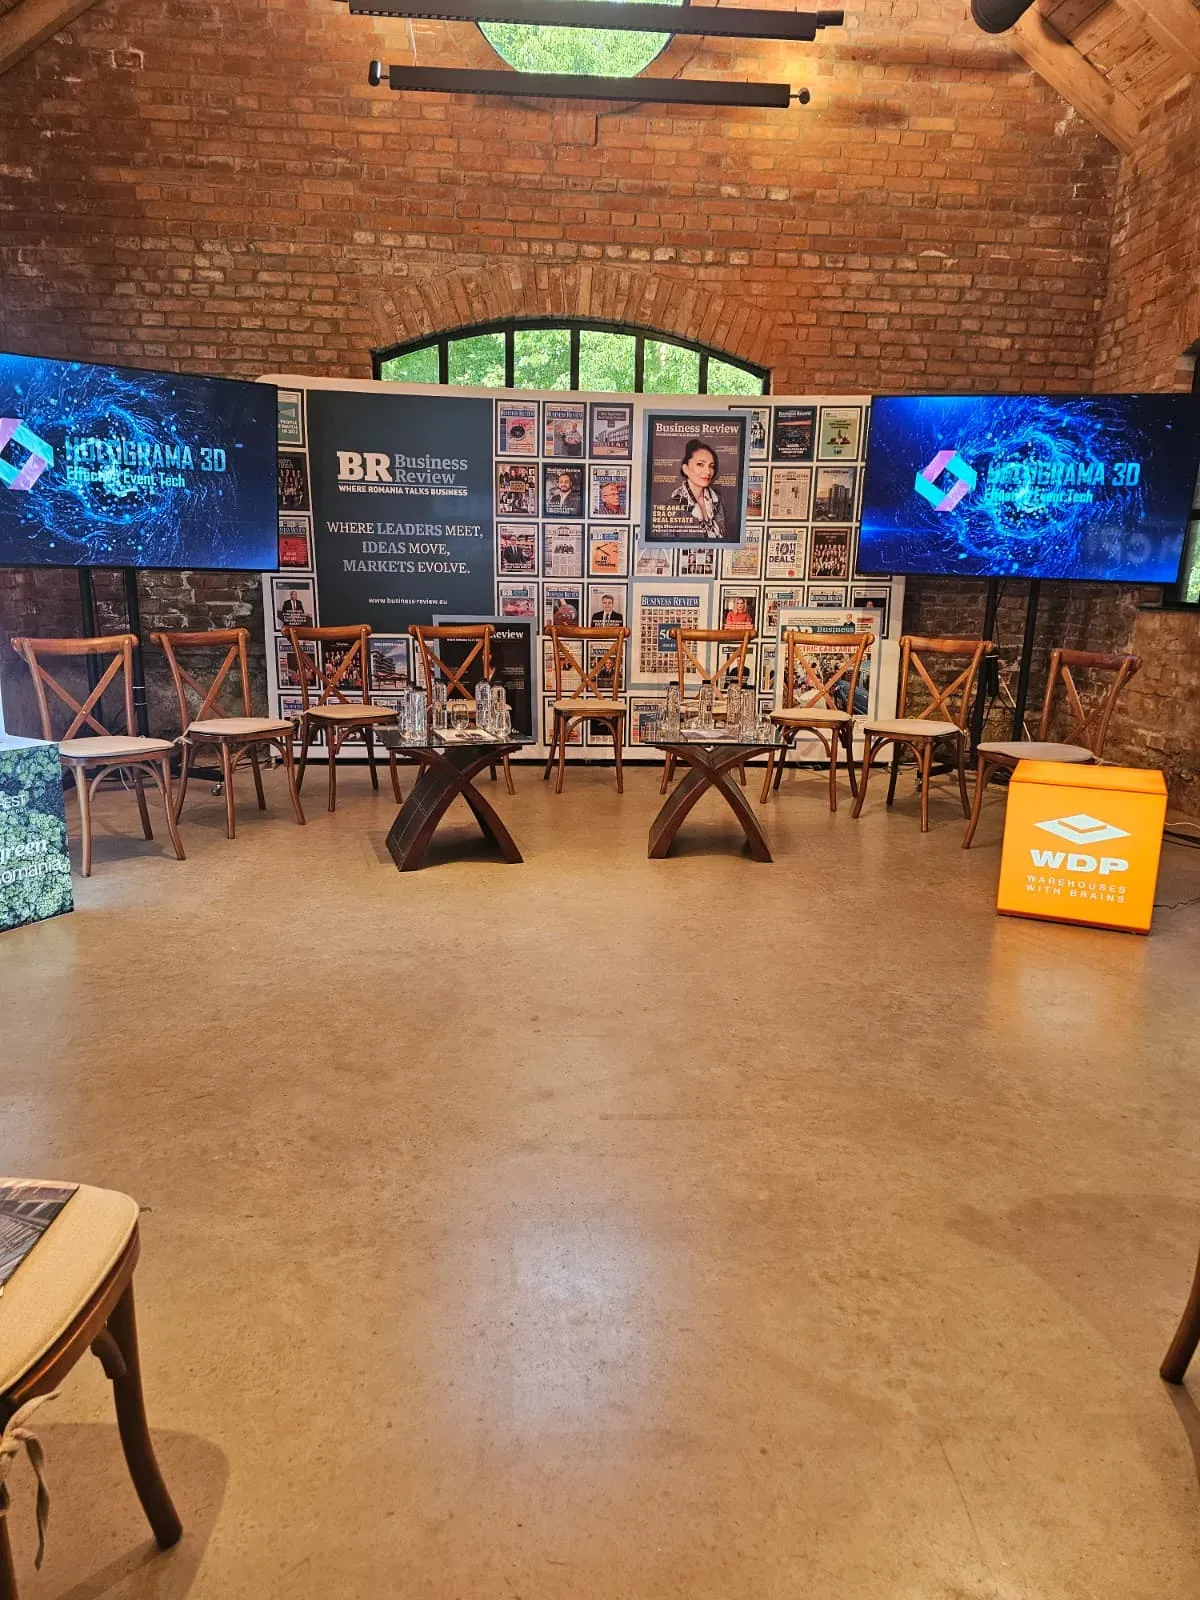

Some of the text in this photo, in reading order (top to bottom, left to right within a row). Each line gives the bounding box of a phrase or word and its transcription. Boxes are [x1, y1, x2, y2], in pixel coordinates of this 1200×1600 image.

[655, 422, 740, 434] Business Review
[201, 447, 226, 472] 3D
[337, 451, 393, 482] BR
[394, 453, 468, 471] Business
[123, 468, 156, 487] Event
[158, 471, 186, 488] Tech
[394, 468, 456, 485] Review
[1111, 462, 1141, 487] 3D
[338, 484, 468, 497] WHERE ROMANIA TALKS BUSINESS
[1066, 488, 1094, 503] Tech
[327, 521, 483, 539] WHERE LEADERS MEET,
[362, 541, 450, 557] IDEAS MOVE,
[343, 559, 471, 575] MARKETS EVOLVE.
[369, 596, 448, 606] www.business-review.eu
[641, 596, 700, 607] BUSINESS REVIEW
[0, 795, 27, 808] EST
[1030, 849, 1129, 876] WDP
[0, 859, 62, 885] omania
[1025, 884, 1125, 903] WITH BRAINS
[1027, 875, 1127, 894] WAREHOUSES
